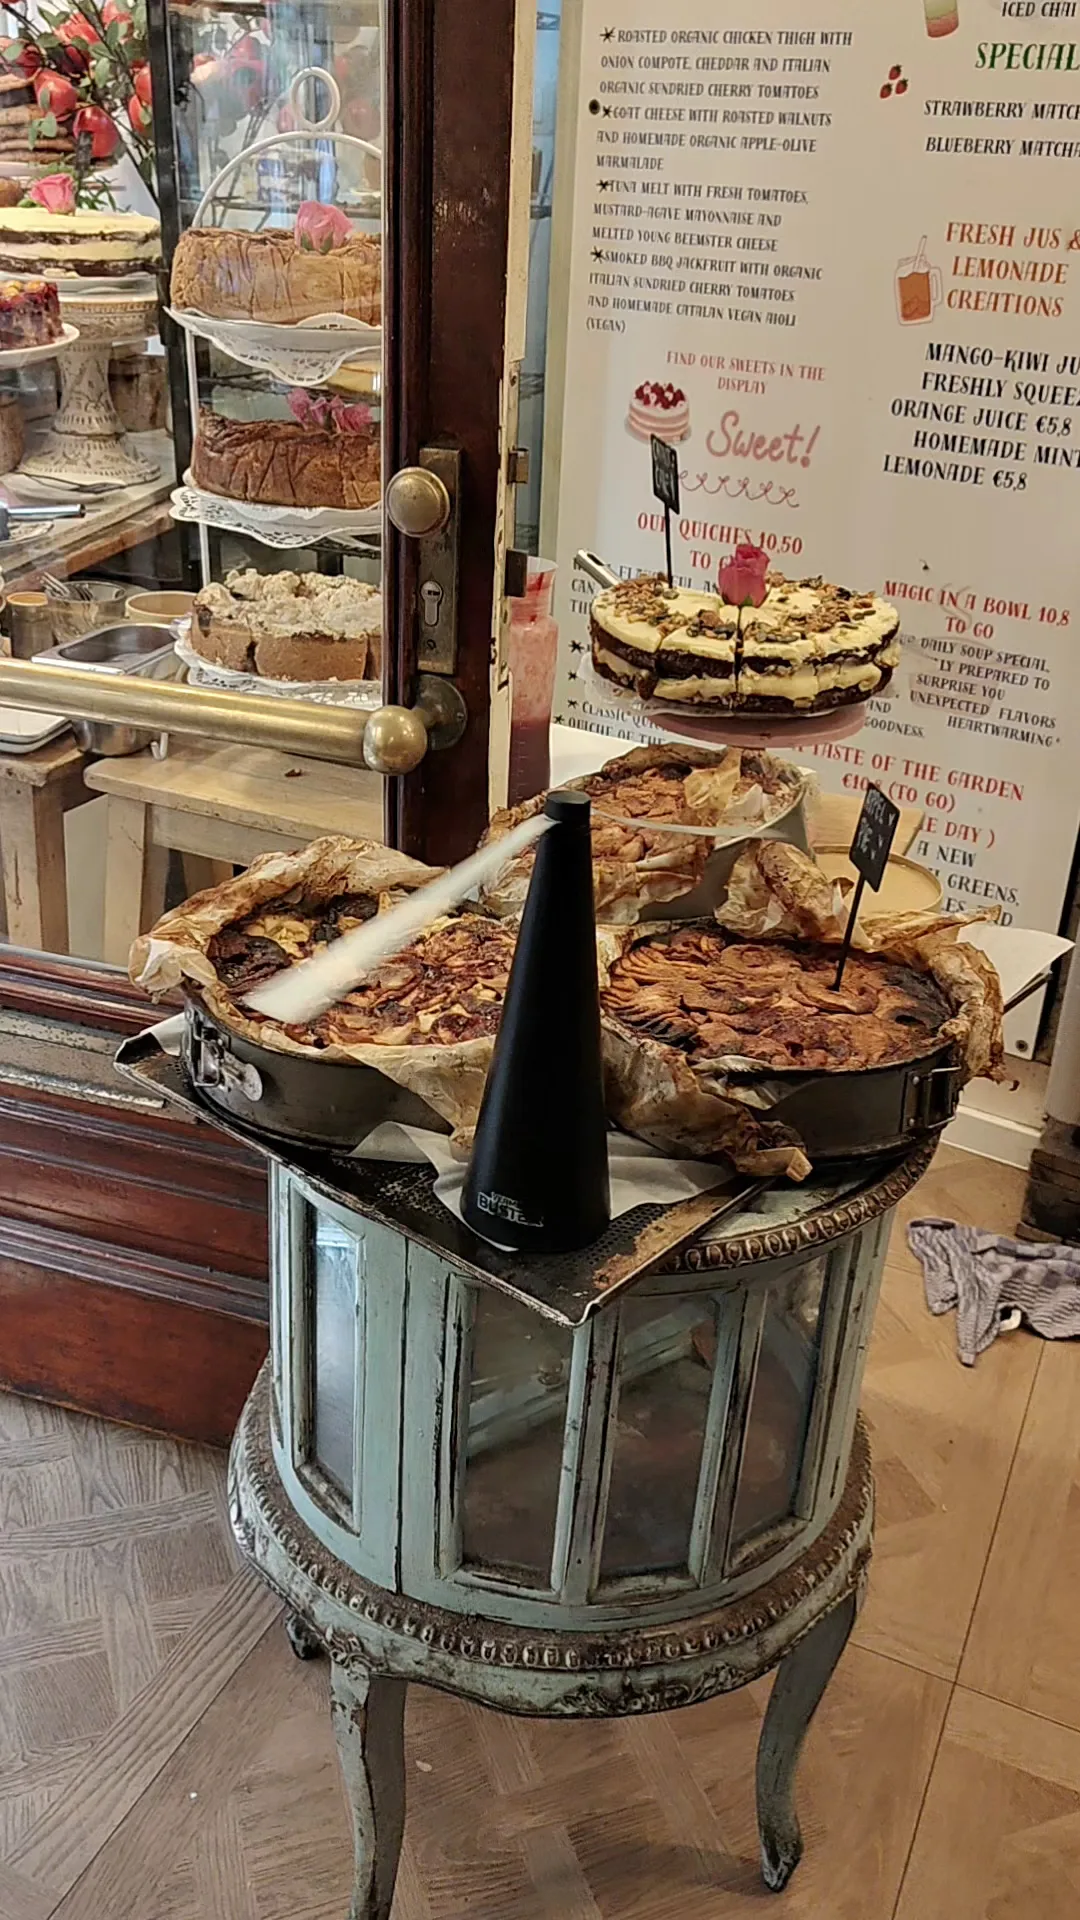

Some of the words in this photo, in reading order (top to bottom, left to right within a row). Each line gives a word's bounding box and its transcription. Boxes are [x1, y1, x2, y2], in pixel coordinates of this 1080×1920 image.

[1001, 2, 1036, 17] ICED
[1041, 2, 1076, 17] CHAI
[618, 30, 667, 43] ROASTED
[671, 31, 719, 44] ORGANIC
[723, 31, 773, 44] CHICKEN
[777, 31, 816, 45] THIGH
[820, 31, 853, 46] WITH
[601, 56, 634, 68] ONION
[696, 57, 750, 71] CHEDDAR
[753, 58, 778, 71] AND
[782, 58, 831, 72] ITALIAN
[975, 42, 1080, 71] SPECIAL
[600, 81, 645, 94] ORGANIC
[649, 82, 704, 96] SUNDRIED
[708, 83, 753, 97] CHERRY
[758, 84, 820, 99] TOMATOES
[644, 107, 686, 121] CHEESE
[689, 109, 719, 123] WITH
[723, 110, 774, 124] ROASTED
[778, 112, 832, 126] WALNUTS
[924, 100, 1027, 119] STRAWBERRY
[597, 130, 619, 143] AND
[623, 131, 686, 147] HOMEMADE
[690, 134, 736, 148] ORGANIC
[741, 136, 816, 152] APPLE-OLIVE
[925, 136, 1016, 155] BLUEBERRY
[596, 155, 664, 171] MARMALADE
[609, 180, 637, 193] TUNA
[641, 182, 670, 195] MELT
[674, 184, 702, 197] WITH
[706, 185, 743, 200] FRESH
[685, 209, 754, 225] MAYONNAISE
[758, 213, 782, 227] AND
[592, 226, 634, 241] MELTED
[638, 229, 671, 244] YOUNG
[674, 232, 732, 248] BEEMSTER
[736, 237, 779, 252] CHEESE
[946, 221, 1016, 247] FRESH
[1023, 227, 1062, 250] JUS
[1066, 229, 1080, 251] &
[604, 251, 648, 265] SMOKED
[651, 254, 673, 271] BBQ
[676, 256, 736, 273] JACKFRUIT
[740, 261, 769, 276] WITH
[773, 265, 824, 280] ORGANIC
[952, 255, 1069, 284] LEMONADE
[589, 272, 630, 287] ITALIAN
[633, 276, 686, 292] SUNDRIED
[689, 281, 733, 297] CHERRY
[737, 285, 796, 302] TOMATOES
[588, 295, 609, 308] AND
[612, 297, 673, 314] HOMEMADE
[676, 304, 723, 319] CATALAN
[728, 308, 763, 323] VEGAN
[765, 312, 797, 326] AIOLI
[946, 288, 1065, 317] CREATIONS
[586, 316, 626, 333] (VEGAN)
[666, 351, 696, 366] FIND
[700, 355, 726, 370] OUR
[729, 358, 776, 376] SWEETS
[780, 363, 794, 378] IN
[799, 365, 826, 382] THE
[925, 342, 1050, 373] MANGO-KIWI
[717, 377, 769, 395] DISPLAY
[921, 371, 1009, 399] FRESHLY
[891, 398, 967, 424] ORANGE
[973, 407, 1028, 432] JUICE
[1036, 415, 1073, 437] €5,8
[706, 410, 821, 468] Sweet!
[913, 430, 1028, 462] HOMEMADE
[883, 453, 986, 486] LEMONADE
[993, 470, 1028, 492] €5,8
[679, 519, 752, 544] QUICHES
[690, 550, 711, 570] TO
[883, 580, 934, 602] MAGIC
[939, 590, 958, 608] IN
[964, 593, 977, 610] A
[983, 597, 1032, 620] BOWL
[1039, 606, 1071, 626] 10,8
[945, 616, 967, 634] TO
[973, 622, 994, 639] GO
[920, 637, 958, 655] DAILY
[960, 644, 995, 661] SOUP
[917, 673, 978, 696] SURPRISE
[982, 685, 1006, 701] YOU
[958, 662, 1029, 687] PREPARED
[1034, 677, 1050, 691] TO
[910, 689, 990, 716] UNEXPECTED
[998, 707, 1057, 729] FLAVORS
[866, 700, 891, 713] AND
[947, 715, 1053, 748] HEARTWARMING
[812, 742, 866, 766] TASTE
[871, 753, 897, 772] OF
[903, 759, 941, 783] THE
[947, 769, 1025, 801] GARDEN
[888, 781, 918, 803] (TO
[925, 791, 956, 813] GO)
[944, 821, 982, 843] DAY
[917, 840, 929, 856] A
[936, 845, 977, 868] NEW
